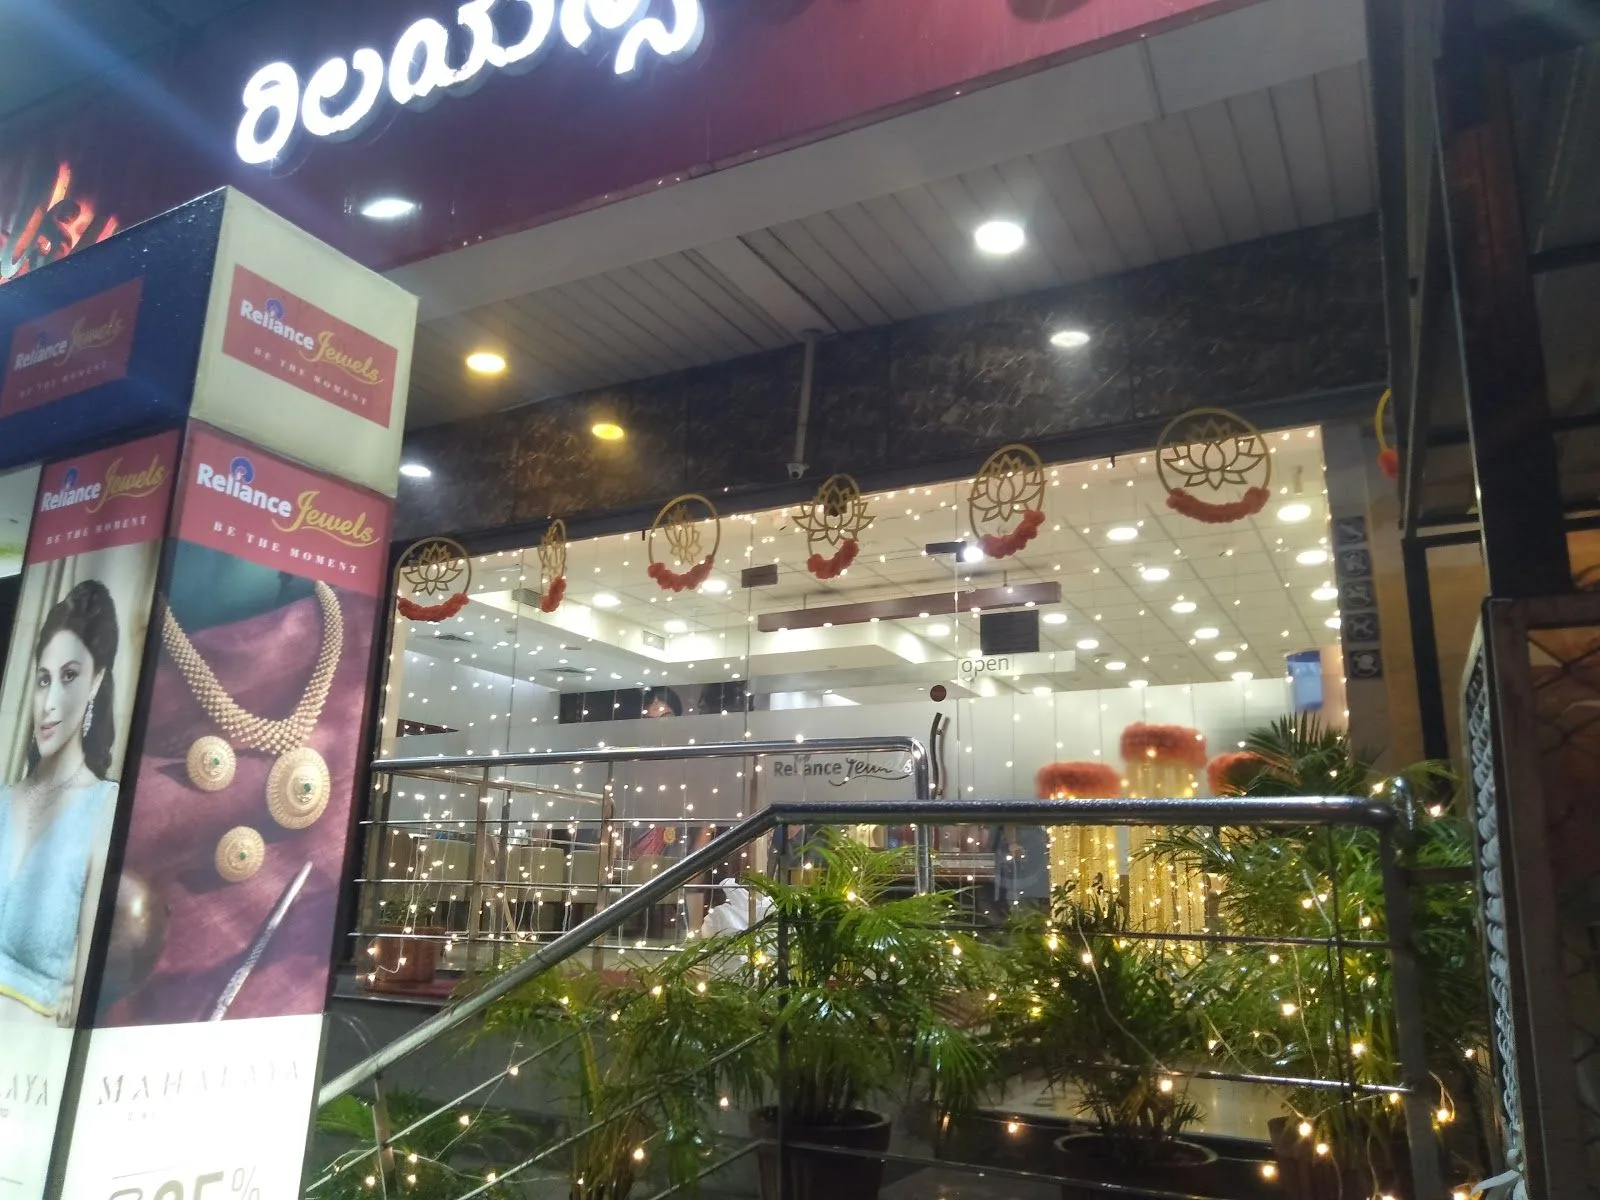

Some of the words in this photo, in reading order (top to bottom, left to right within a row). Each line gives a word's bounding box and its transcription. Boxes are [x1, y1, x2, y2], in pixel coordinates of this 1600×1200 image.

[240, 299, 315, 351] Reliance
[299, 331, 384, 385] Jewels
[313, 375, 367, 405] MOMENT
[41, 480, 101, 512] Reliance
[86, 455, 168, 514] Jewels
[197, 463, 292, 518] Reliance
[271, 490, 380, 547] Jewels
[46, 533, 62, 545] BE
[67, 528, 88, 541] THE
[96, 515, 148, 534] MOMENT
[213, 521, 236, 537] BE
[247, 533, 280, 553] THE
[290, 547, 359, 575] MOMENT
[962, 657, 1009, 677] open
[774, 760, 841, 777] Relance
